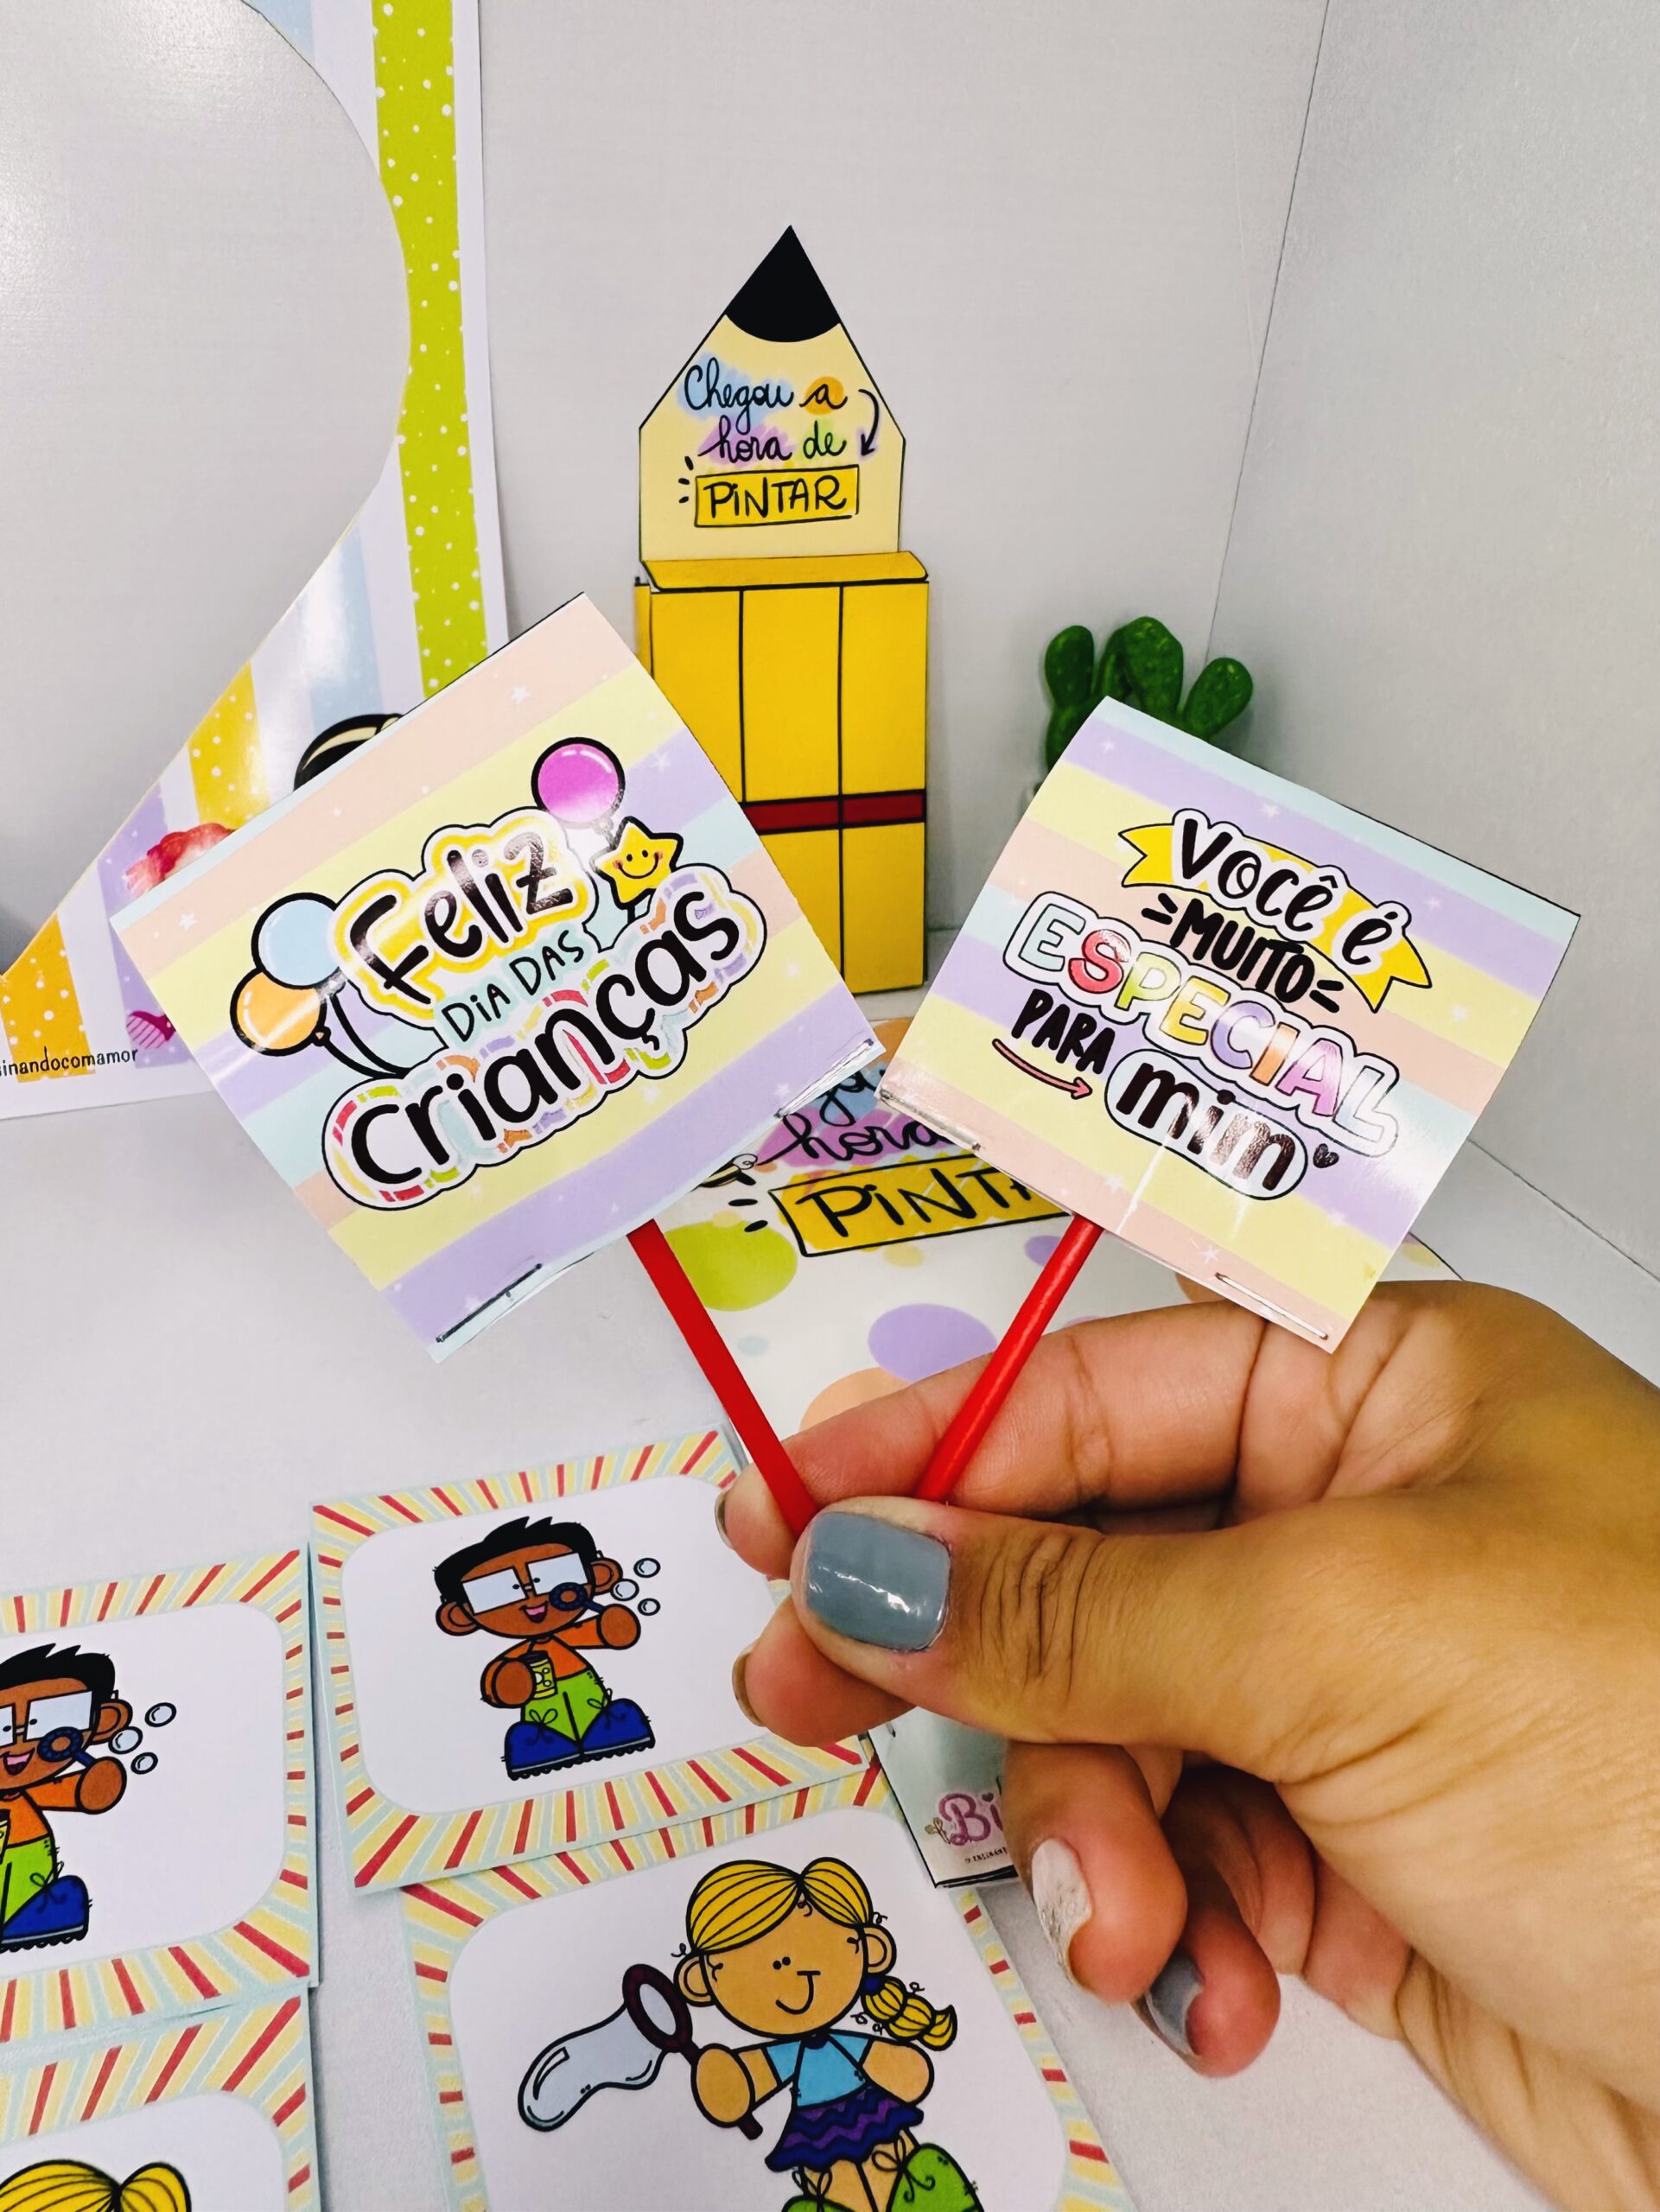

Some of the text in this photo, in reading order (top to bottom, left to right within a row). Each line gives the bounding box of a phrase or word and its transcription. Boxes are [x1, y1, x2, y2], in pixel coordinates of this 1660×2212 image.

[684, 358, 848, 435] Chegou a
[697, 415, 847, 462] hora de
[349, 832, 573, 1005] Feliz
[1177, 819, 1338, 931] Você
[510, 930, 583, 996] DAS
[1169, 899, 1315, 1002] MUITO
[1012, 988, 1115, 1074] PARA
[1017, 902, 1391, 1144] ESPECIAL
[1116, 1063, 1296, 1191] mim
